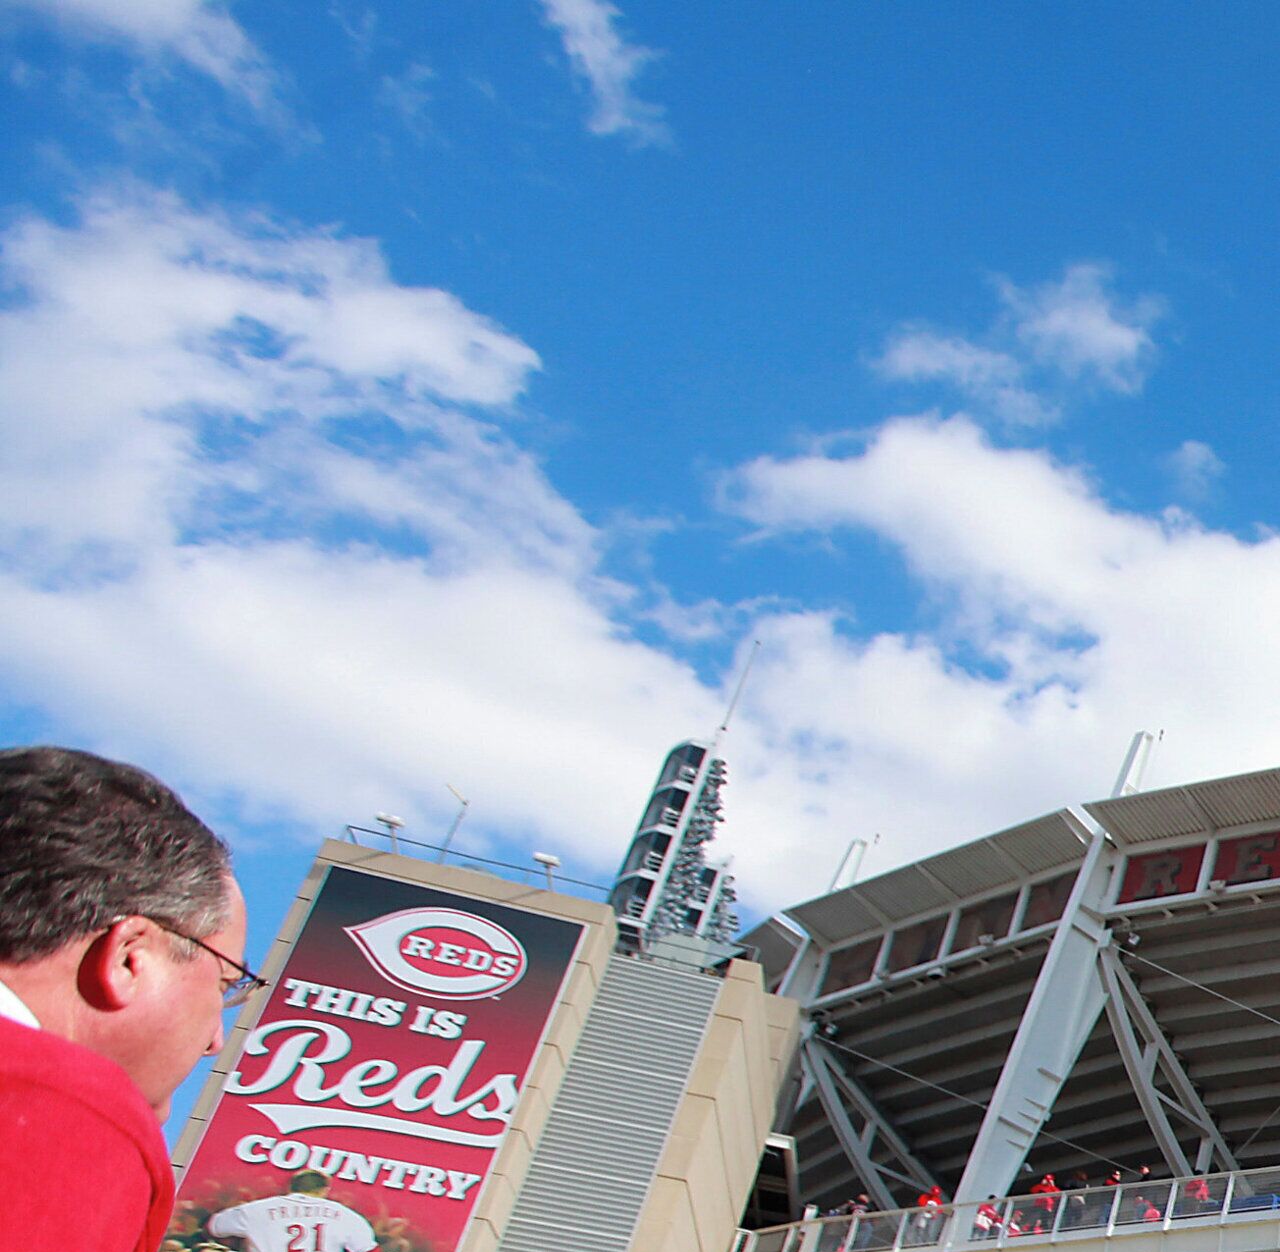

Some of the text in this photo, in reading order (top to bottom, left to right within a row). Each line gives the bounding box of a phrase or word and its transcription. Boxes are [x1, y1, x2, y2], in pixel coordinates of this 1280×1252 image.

[401, 934, 520, 977] REDS
[284, 978, 468, 1039] THIS IS
[222, 1019, 519, 1124] Reds
[235, 1134, 481, 1200] COUNTRY
